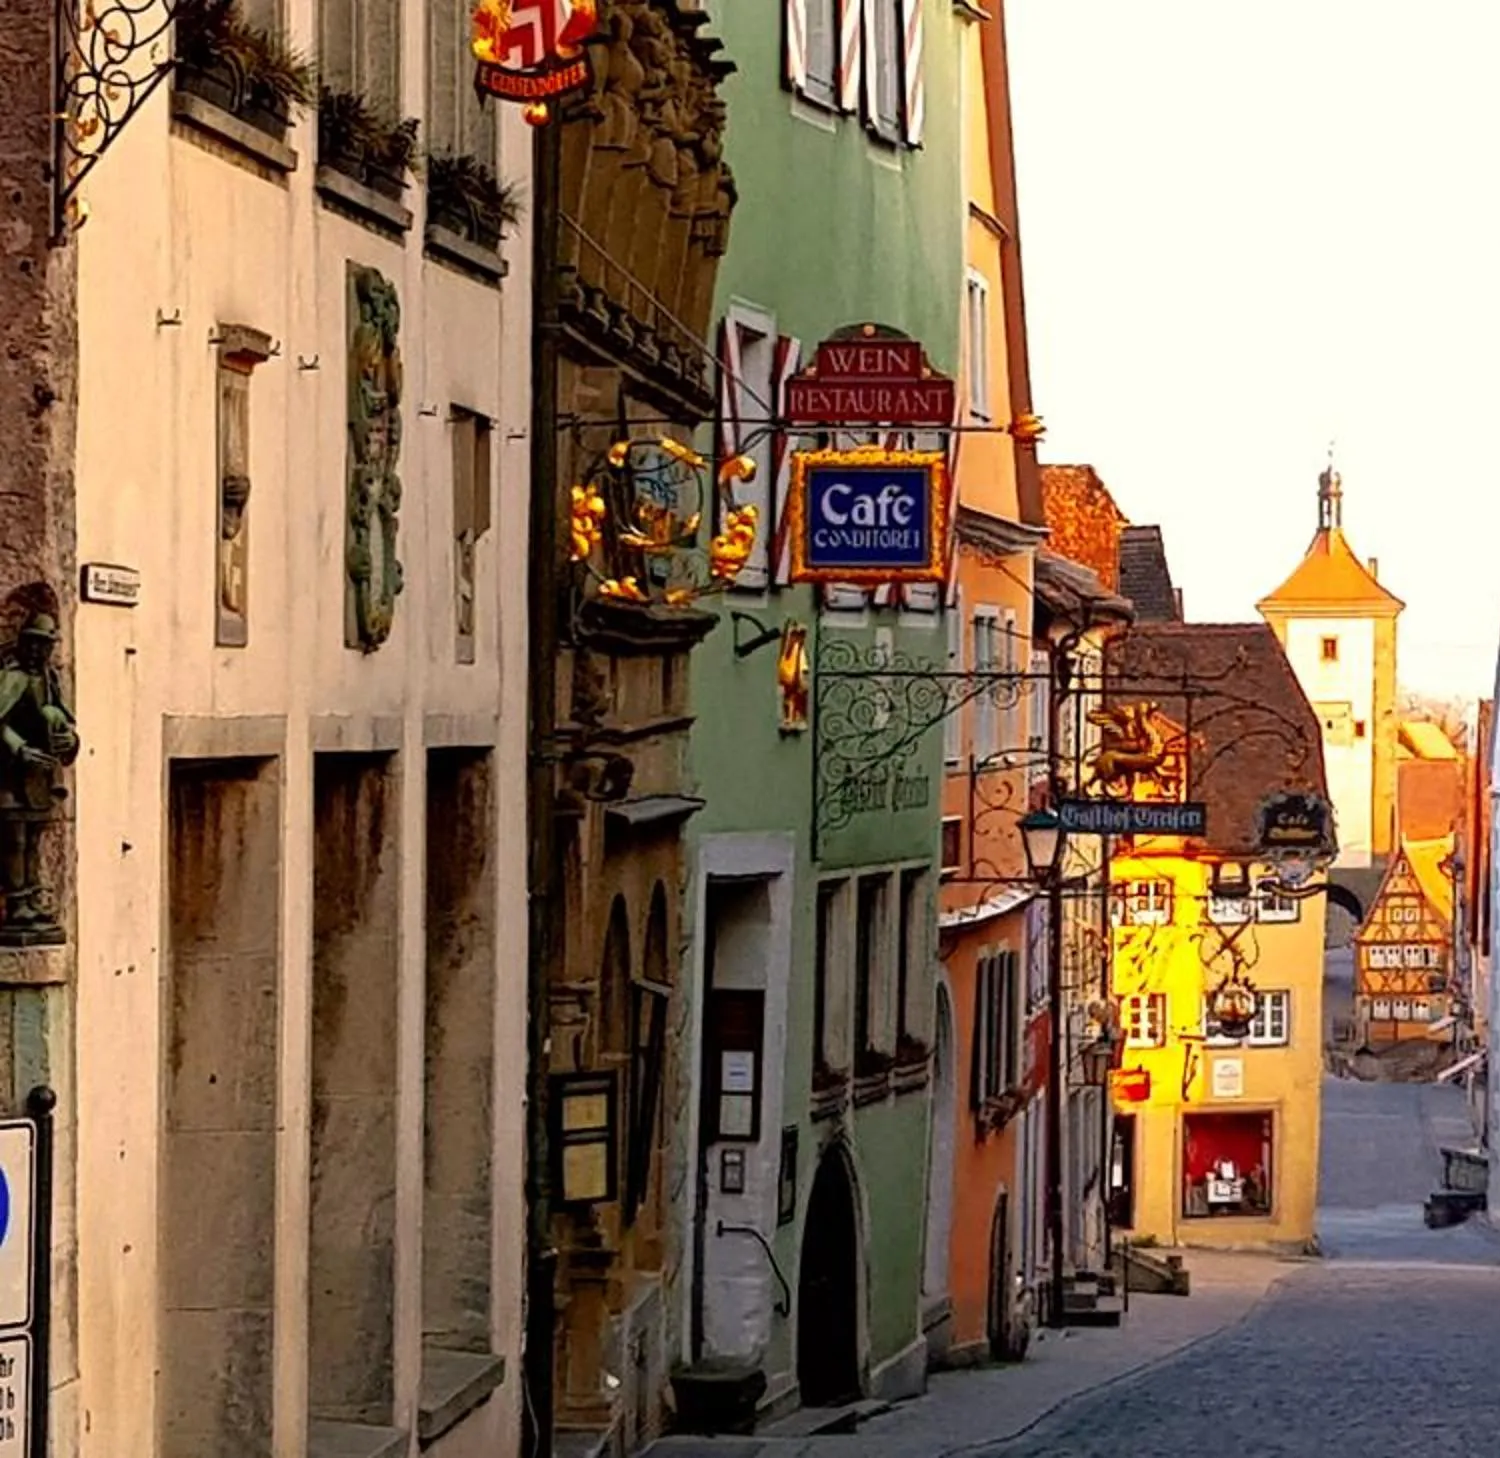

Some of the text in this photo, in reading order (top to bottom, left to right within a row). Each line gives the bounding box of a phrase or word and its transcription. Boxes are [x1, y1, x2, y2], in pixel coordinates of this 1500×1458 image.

[828, 349, 912, 373] WEIN
[790, 388, 948, 415] RESTAURANT
[813, 528, 920, 549] CONDITOREI
